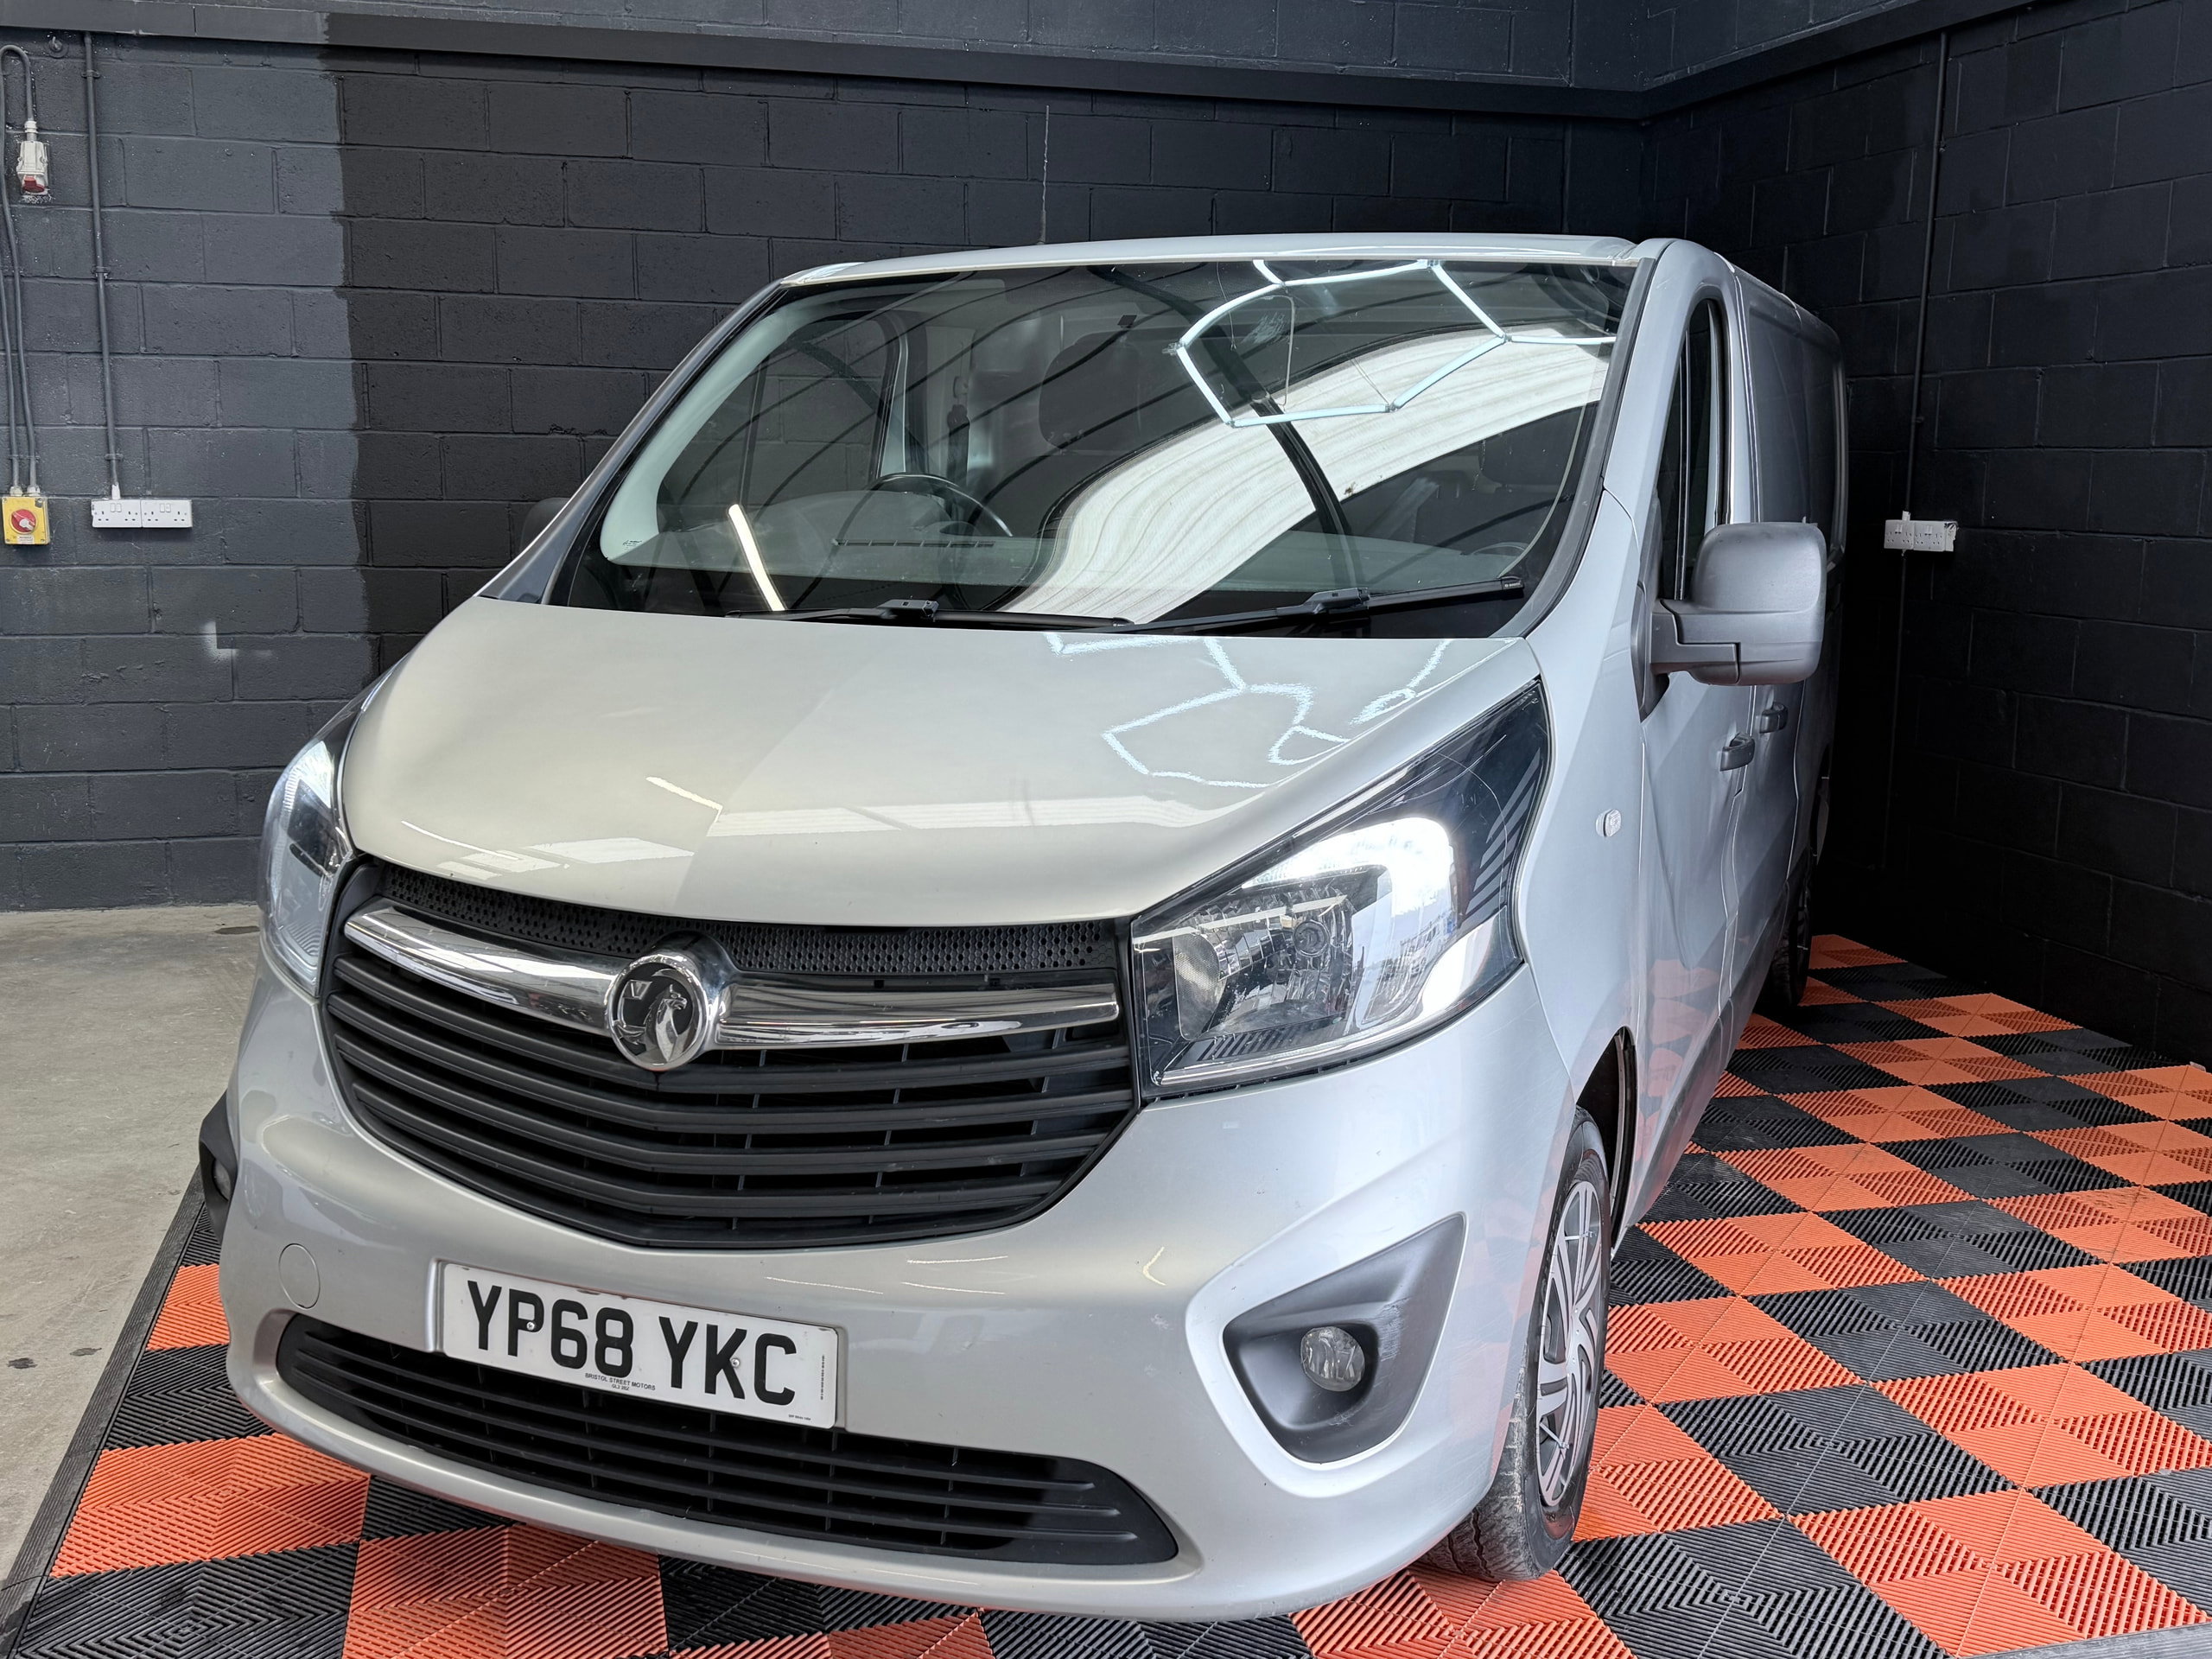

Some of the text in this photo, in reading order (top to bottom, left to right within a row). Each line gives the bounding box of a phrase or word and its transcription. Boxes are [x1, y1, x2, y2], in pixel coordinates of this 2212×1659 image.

[467, 1281, 633, 1378] YP68
[658, 1316, 797, 1406] YKC
[585, 1372, 656, 1391] BRISTOL STREET MOTORS
